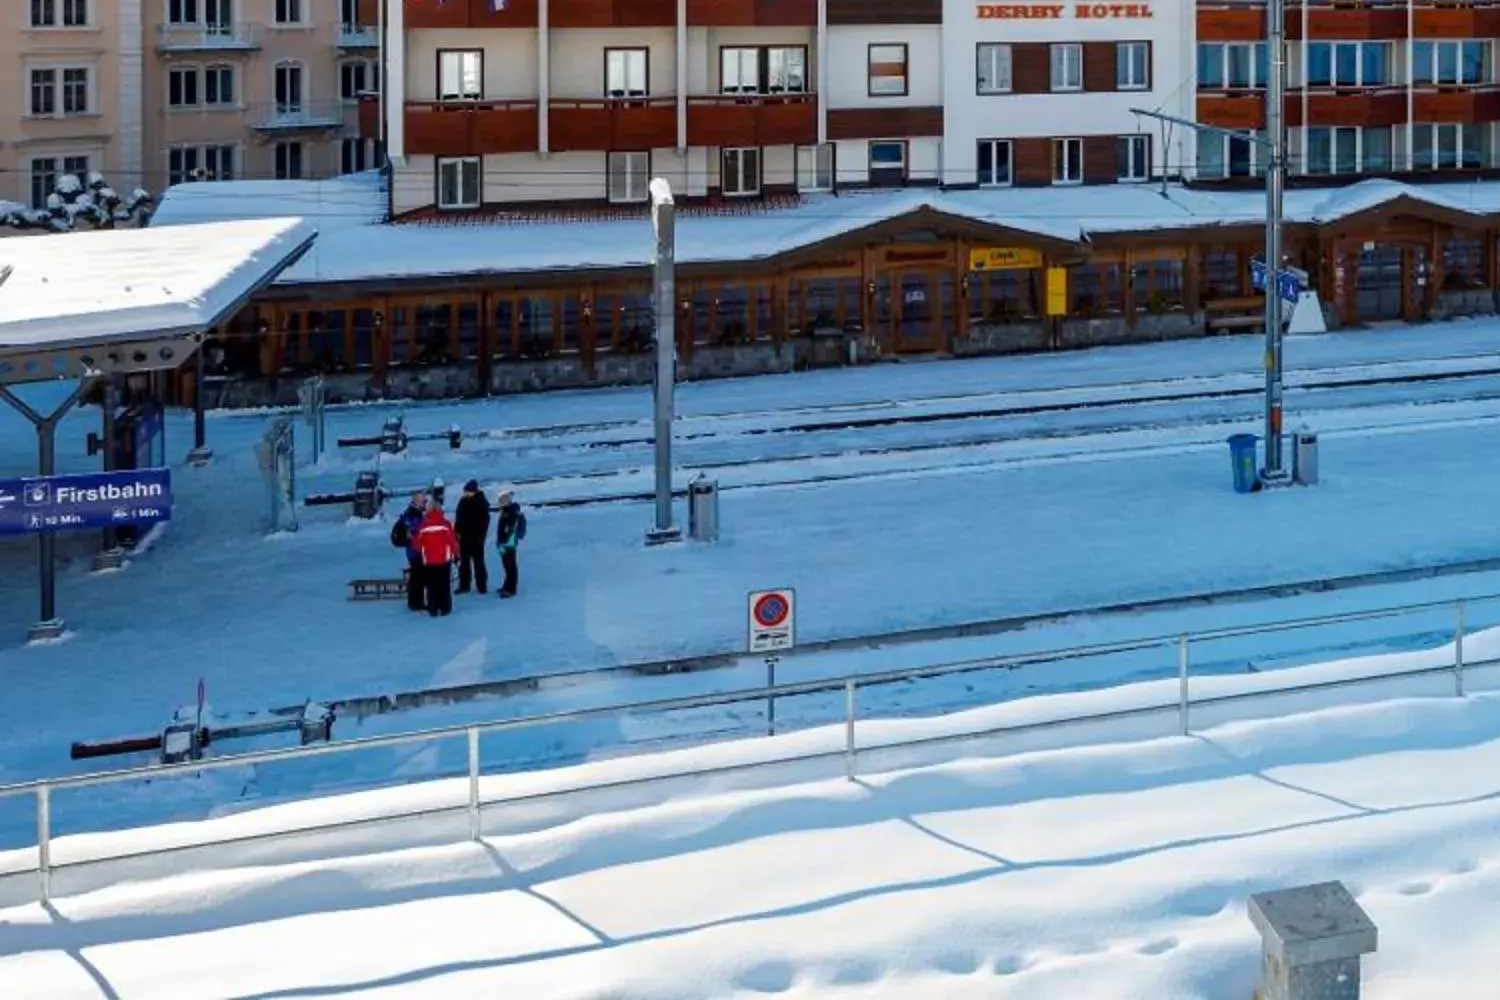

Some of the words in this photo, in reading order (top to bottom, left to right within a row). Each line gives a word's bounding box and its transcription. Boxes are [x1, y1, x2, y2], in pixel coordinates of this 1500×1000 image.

[976, 4, 1064, 19] DERBY
[1074, 3, 1153, 19] HOTEL
[56, 481, 162, 503] Firstbahn
